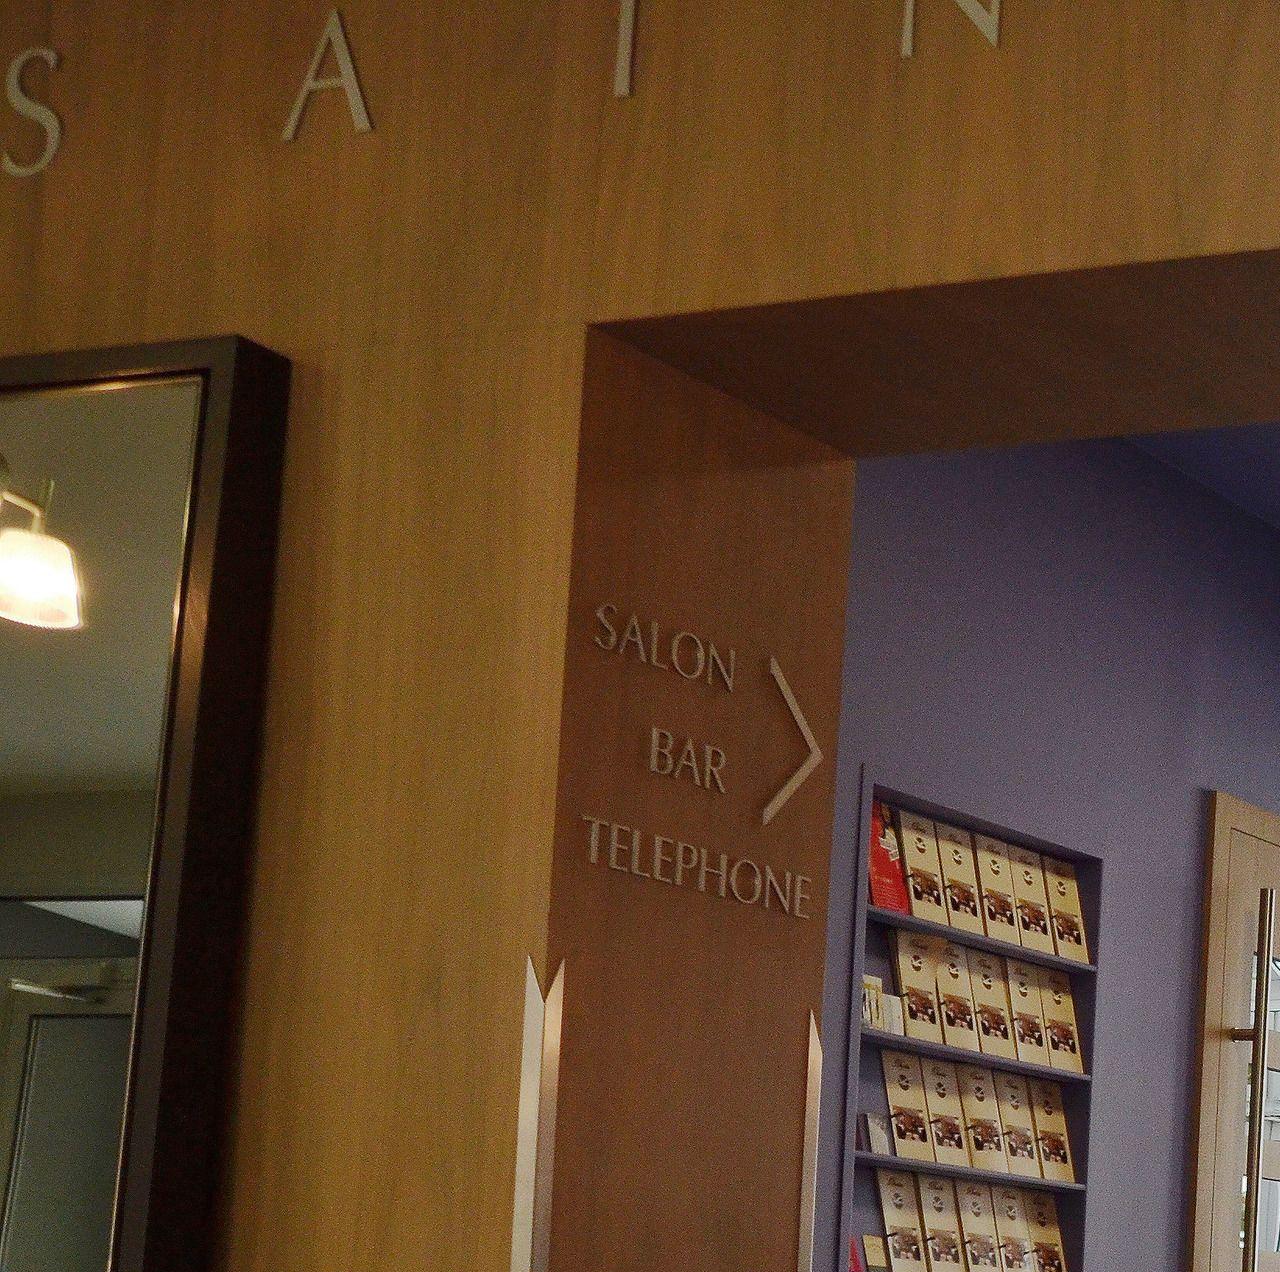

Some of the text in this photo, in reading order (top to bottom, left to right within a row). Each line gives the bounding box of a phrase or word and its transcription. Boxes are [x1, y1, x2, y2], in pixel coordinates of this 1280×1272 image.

[594, 603, 736, 692] SALON
[650, 726, 727, 794] BAR
[582, 815, 812, 919] TELEPHONE
